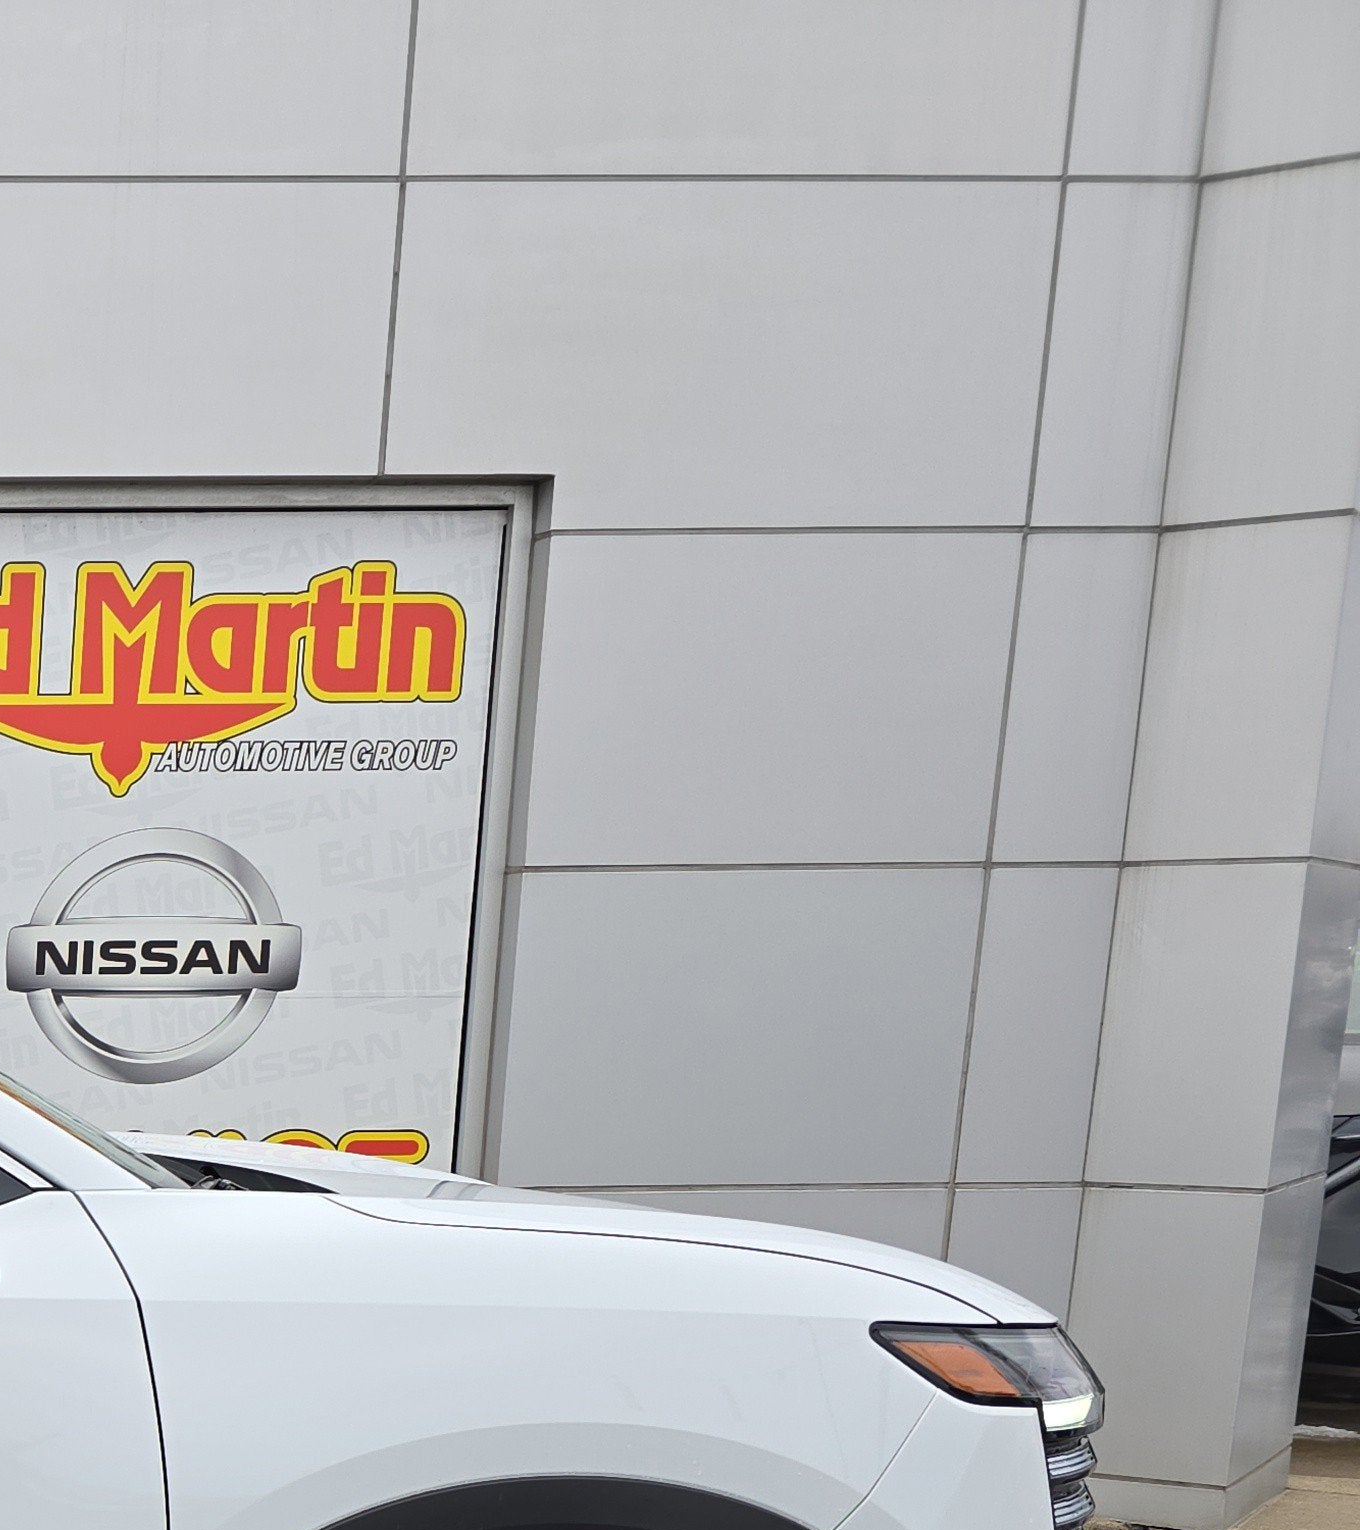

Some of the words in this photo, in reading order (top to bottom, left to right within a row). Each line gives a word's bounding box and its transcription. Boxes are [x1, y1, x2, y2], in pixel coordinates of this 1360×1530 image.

[68, 560, 467, 706] Martin
[154, 739, 348, 773] AUTOMOTIVE
[350, 738, 458, 773] GROUP
[35, 938, 272, 977] NISSAN
